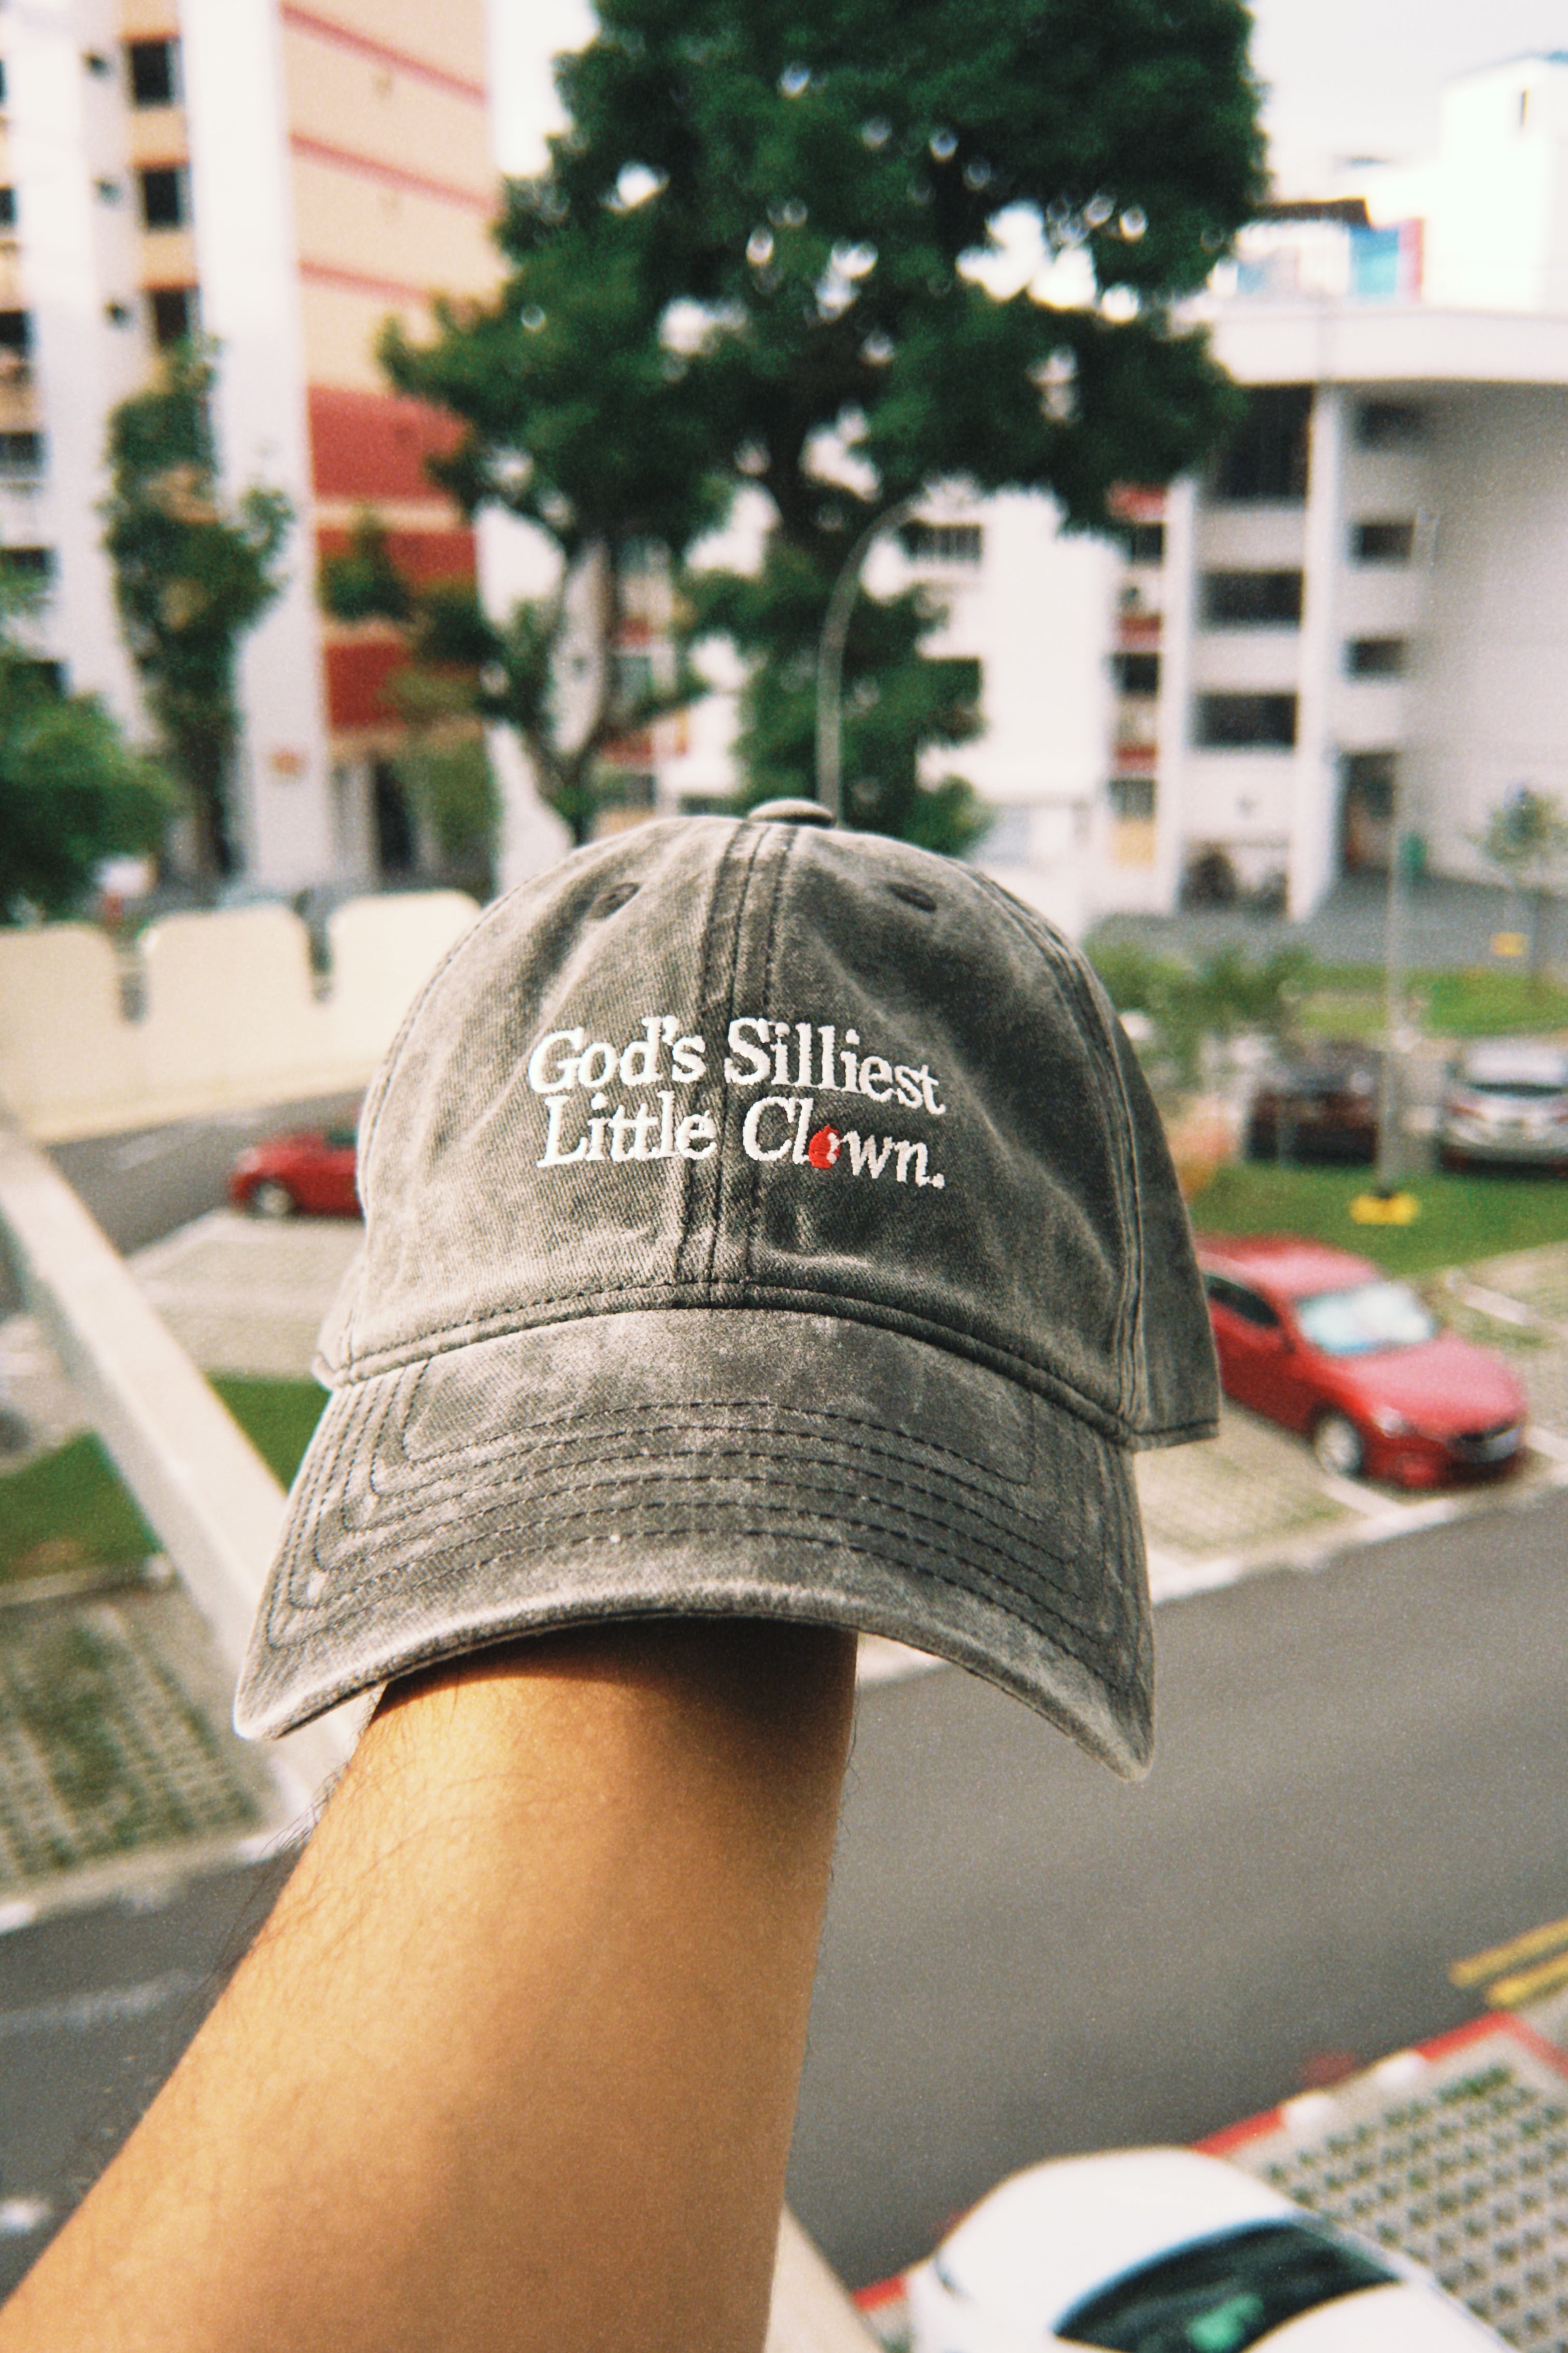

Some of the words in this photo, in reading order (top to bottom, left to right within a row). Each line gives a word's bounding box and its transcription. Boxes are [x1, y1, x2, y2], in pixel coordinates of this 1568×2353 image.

[528, 1015, 707, 1093] God's
[725, 1017, 945, 1114] Silliest
[536, 1091, 717, 1167] Little
